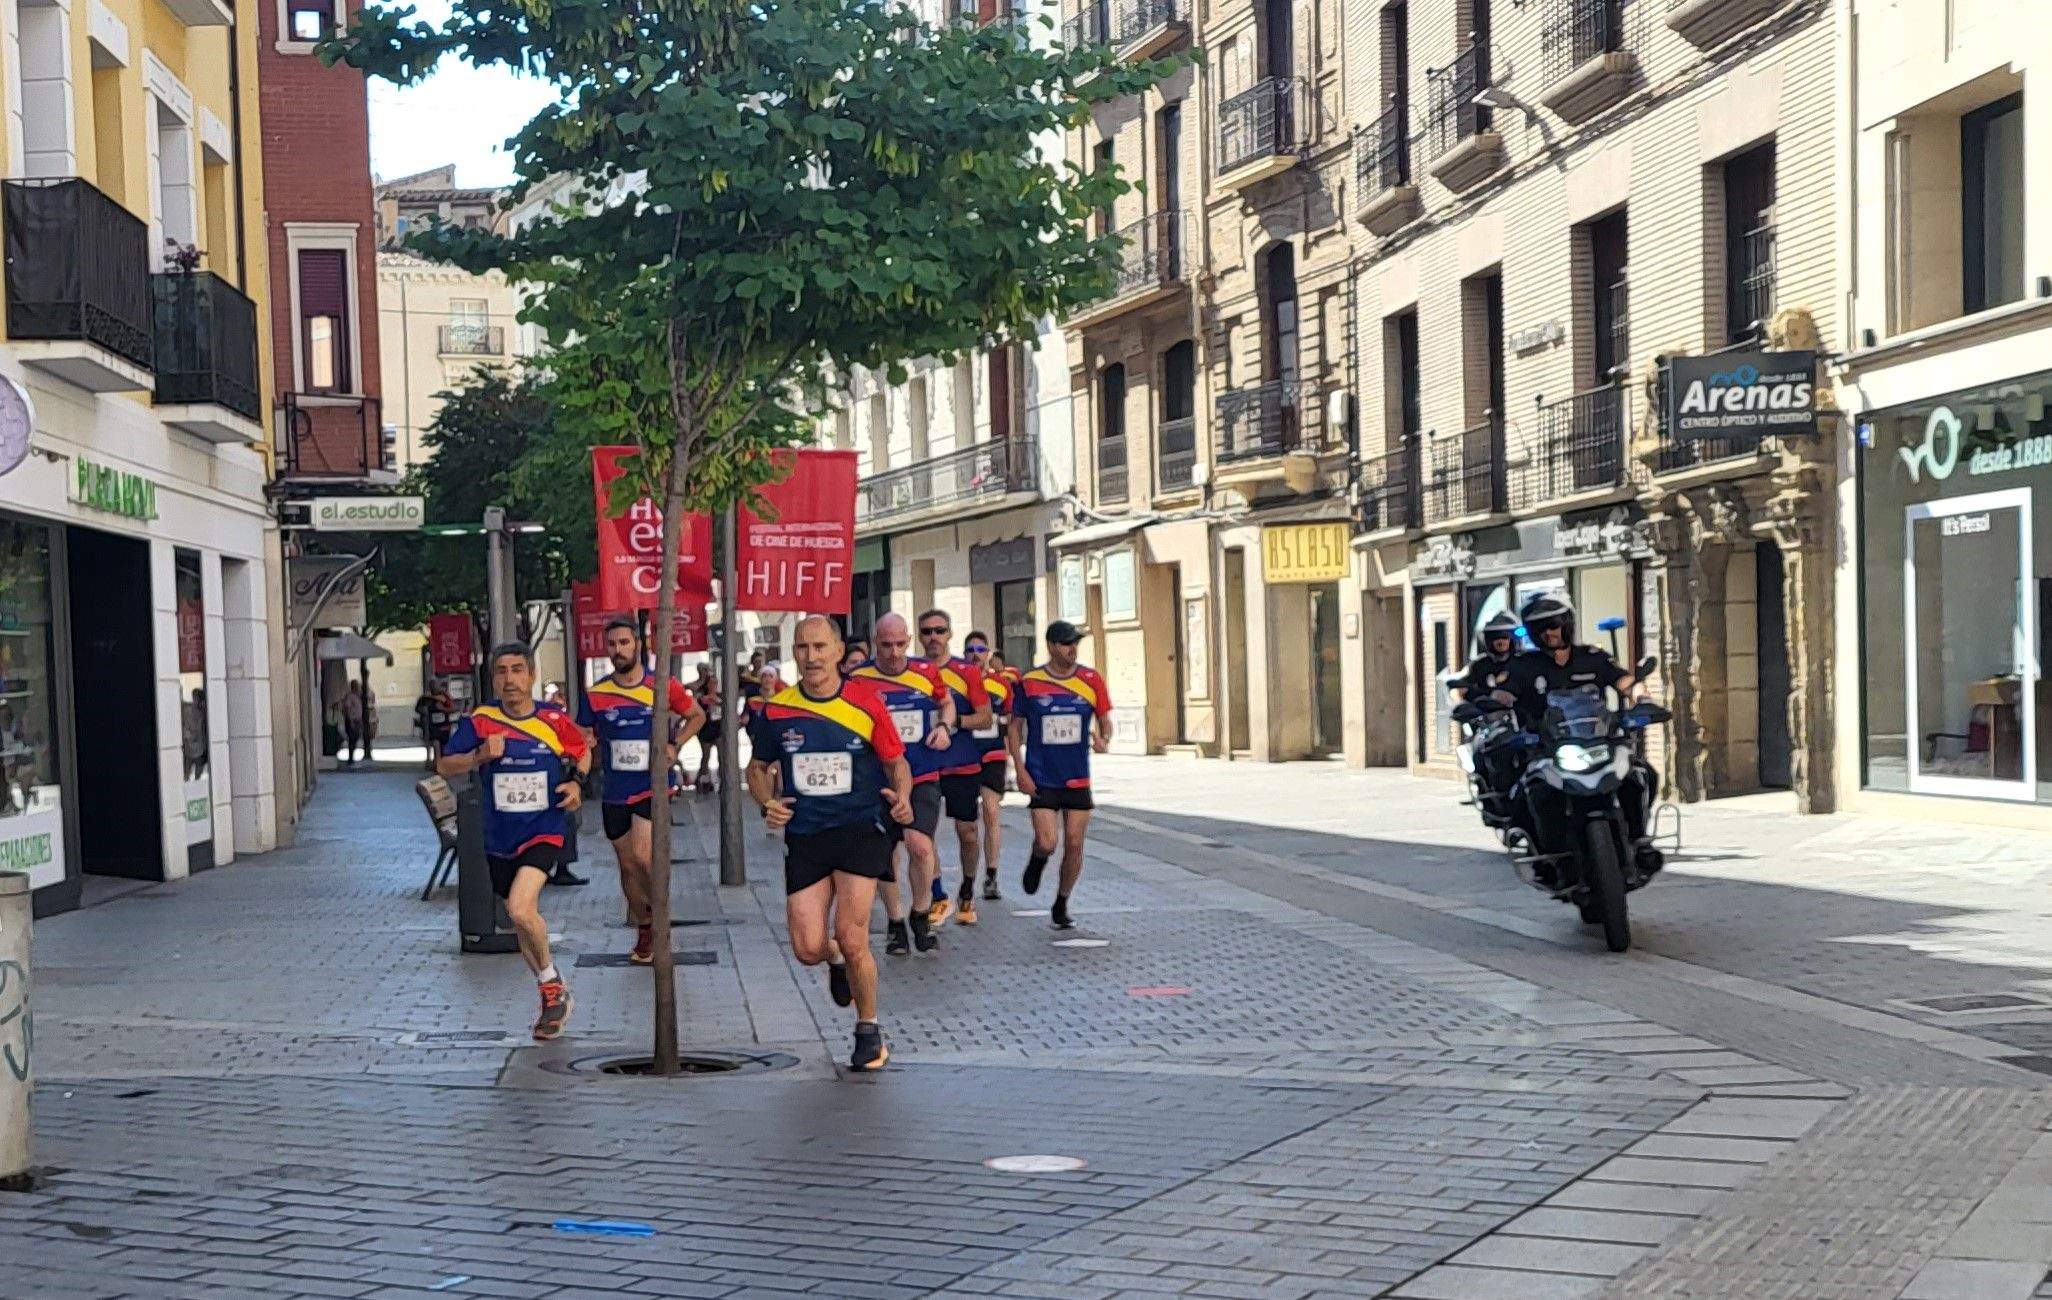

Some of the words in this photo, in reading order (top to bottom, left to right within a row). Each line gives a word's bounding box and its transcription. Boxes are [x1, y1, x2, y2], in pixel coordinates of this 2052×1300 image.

[1679, 380, 1812, 413] Arenas
[1969, 443, 2012, 475] desde
[321, 502, 419, 519] el.estudio
[1268, 527, 1344, 569] ASCASO
[746, 560, 844, 598] HIFF
[806, 773, 838, 786] 621
[507, 791, 538, 805] 624
